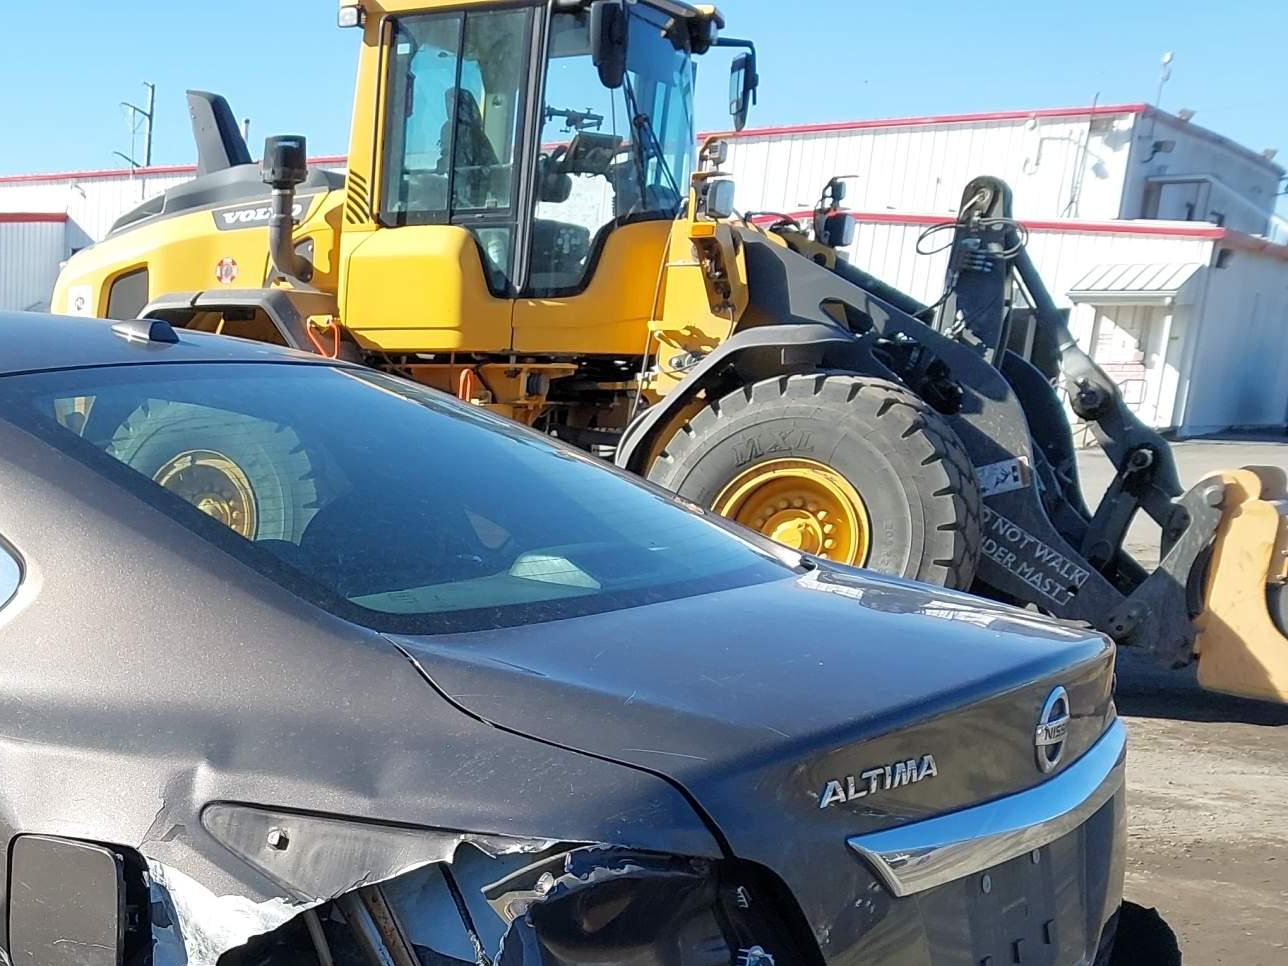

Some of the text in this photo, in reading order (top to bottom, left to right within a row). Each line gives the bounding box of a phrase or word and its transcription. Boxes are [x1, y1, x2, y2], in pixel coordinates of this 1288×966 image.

[982, 537, 1067, 597] DER MAST
[992, 518, 1034, 549] NOT
[1034, 543, 1085, 586] WALK
[819, 754, 939, 809] ALTIMA
